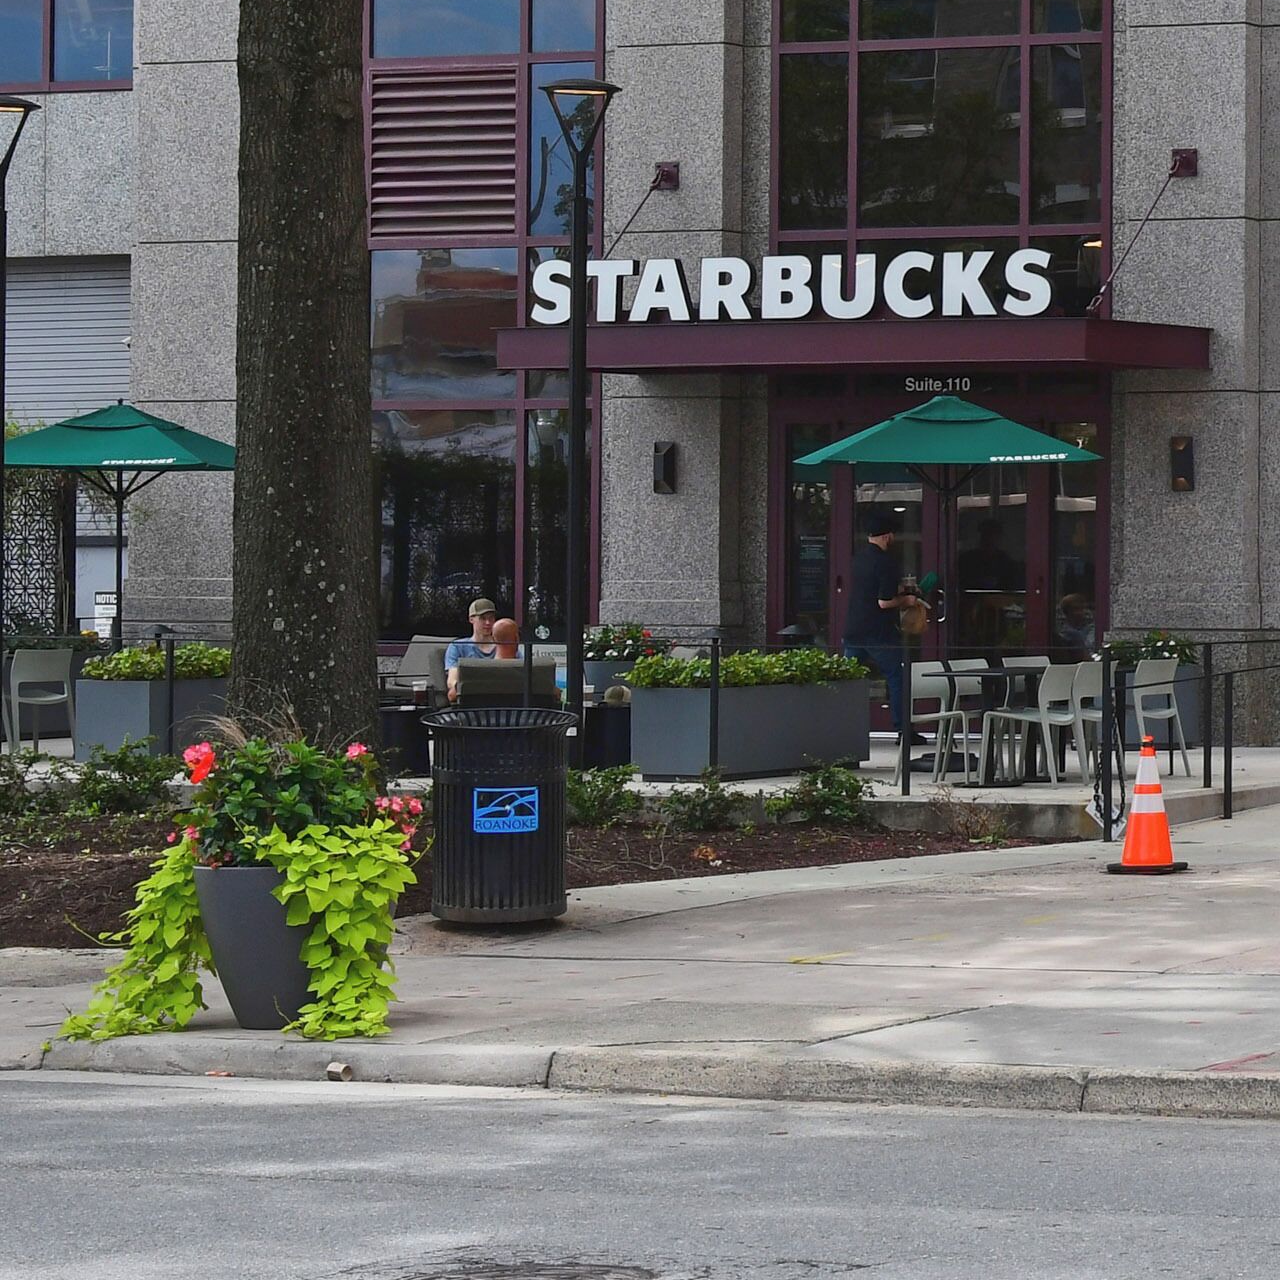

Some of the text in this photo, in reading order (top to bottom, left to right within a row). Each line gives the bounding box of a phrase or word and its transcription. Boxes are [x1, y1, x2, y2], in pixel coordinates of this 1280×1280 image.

[531, 248, 1054, 325] STARBUCKS
[905, 377, 971, 392] Suite 110
[96, 594, 117, 604] NOTIC
[475, 817, 537, 830] ROANOKE
